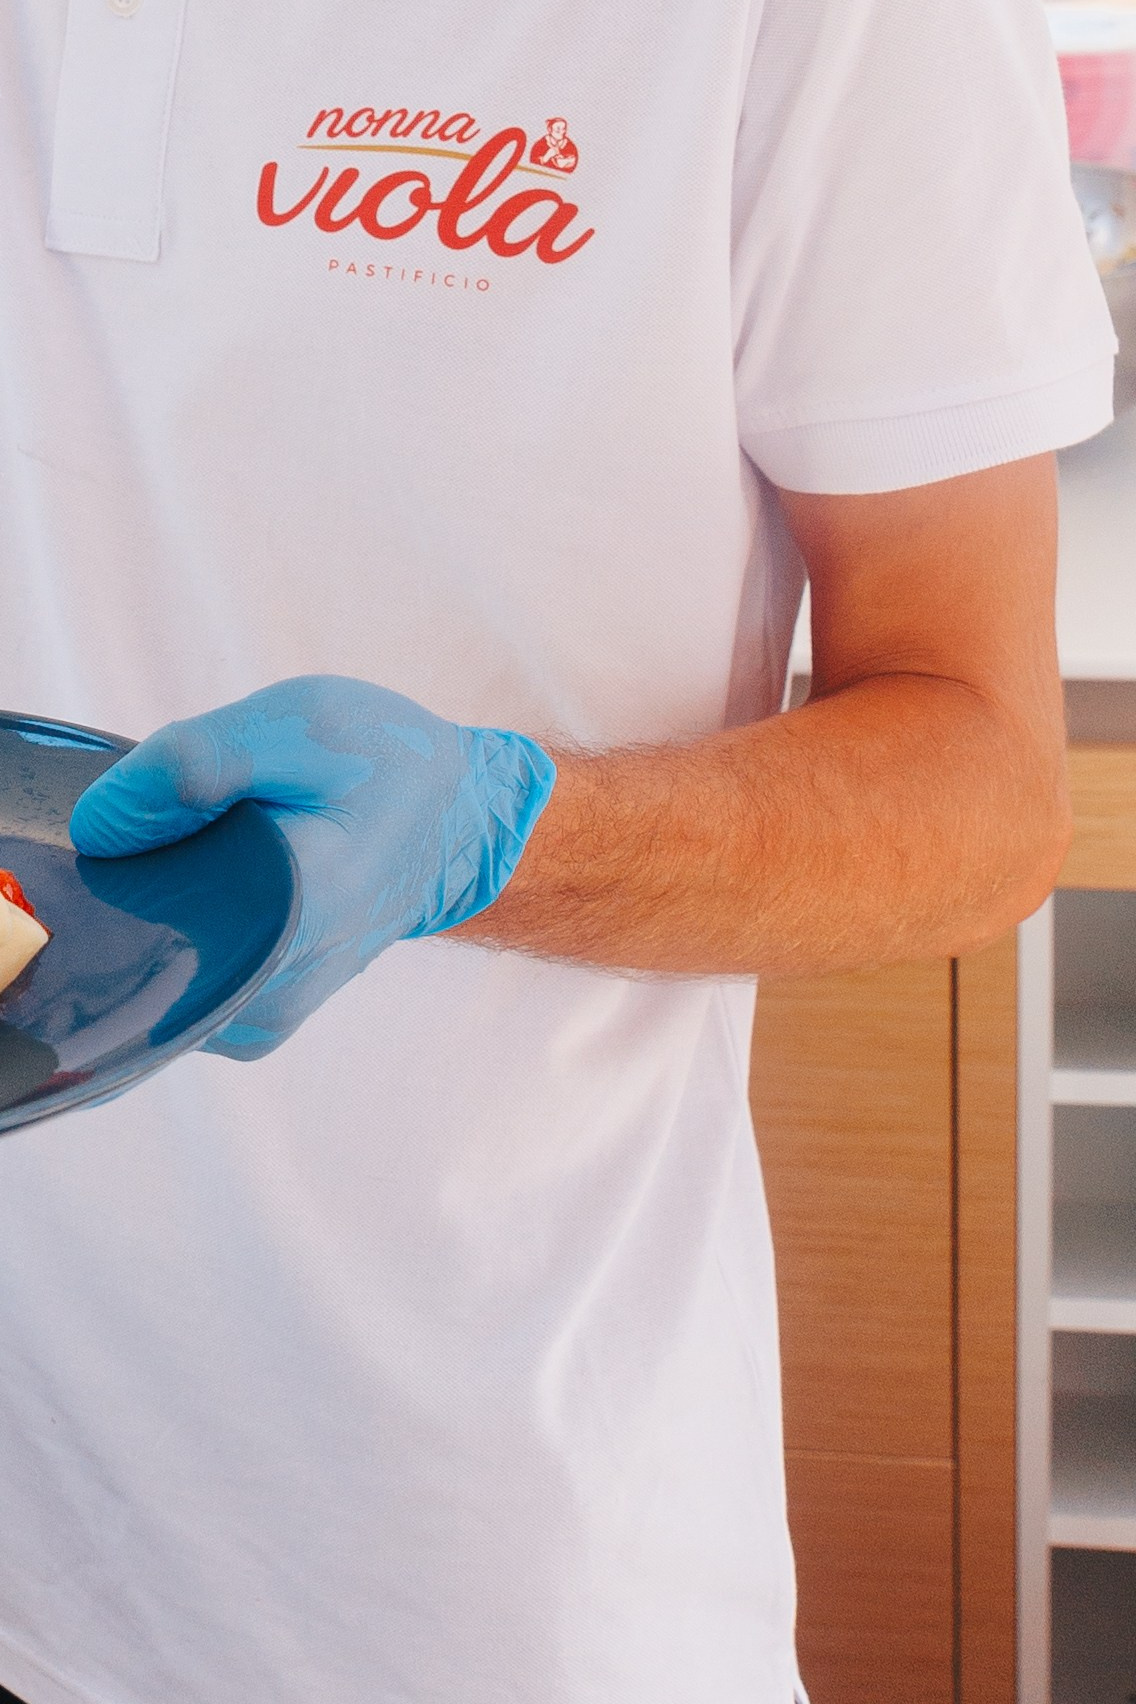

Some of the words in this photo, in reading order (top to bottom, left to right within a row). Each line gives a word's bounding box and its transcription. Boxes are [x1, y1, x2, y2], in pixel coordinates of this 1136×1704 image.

[306, 106, 481, 144] nonna
[257, 127, 595, 264] viola
[328, 259, 491, 292] PASTIFICIO
